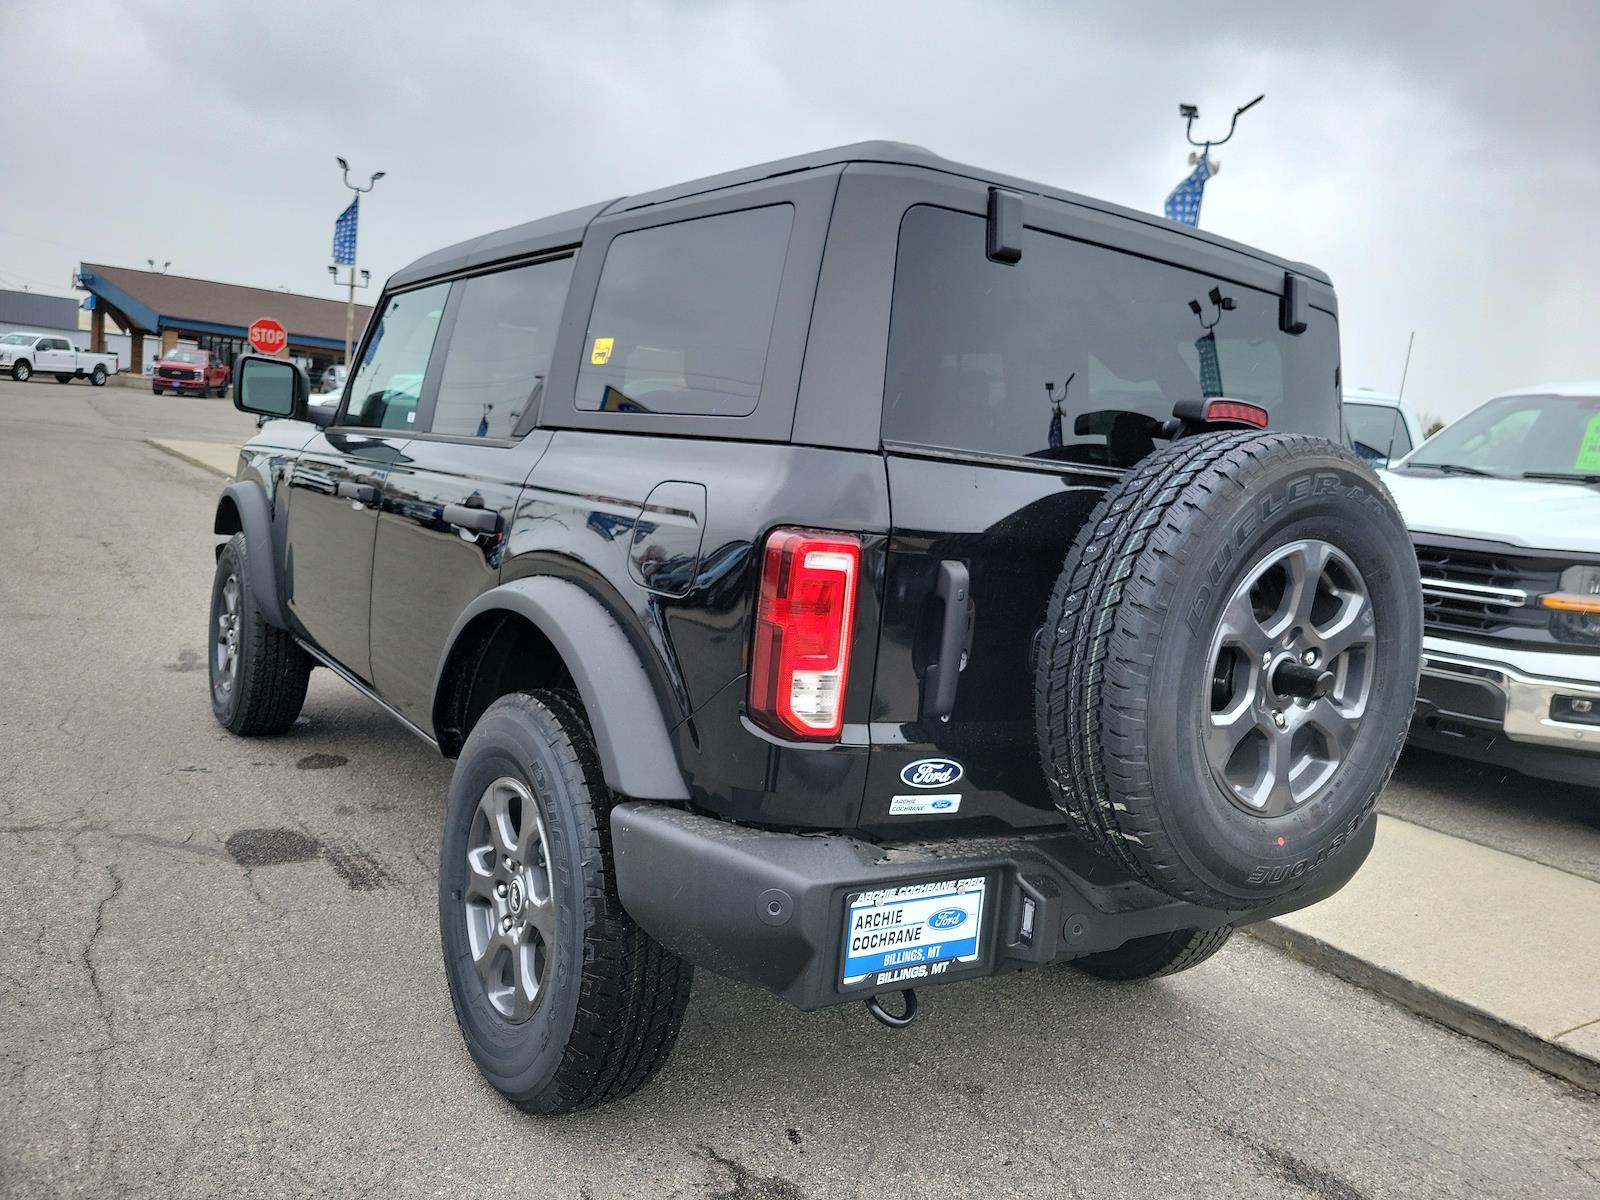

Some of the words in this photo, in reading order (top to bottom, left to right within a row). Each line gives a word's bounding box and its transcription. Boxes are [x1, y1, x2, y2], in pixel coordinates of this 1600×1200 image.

[251, 326, 285, 345] STOP
[912, 762, 953, 784] Ford
[855, 887, 898, 904] ARCHIE
[897, 881, 958, 897] COCHRANE
[956, 876, 986, 889] FORD
[855, 909, 904, 931] ARCHIE
[934, 910, 961, 928] Ford
[852, 927, 922, 951] COCHRANE
[883, 947, 925, 967] BILLINGS,
[927, 945, 942, 959] MT
[876, 964, 929, 985] BILLINGS,
[930, 961, 950, 976] MT
